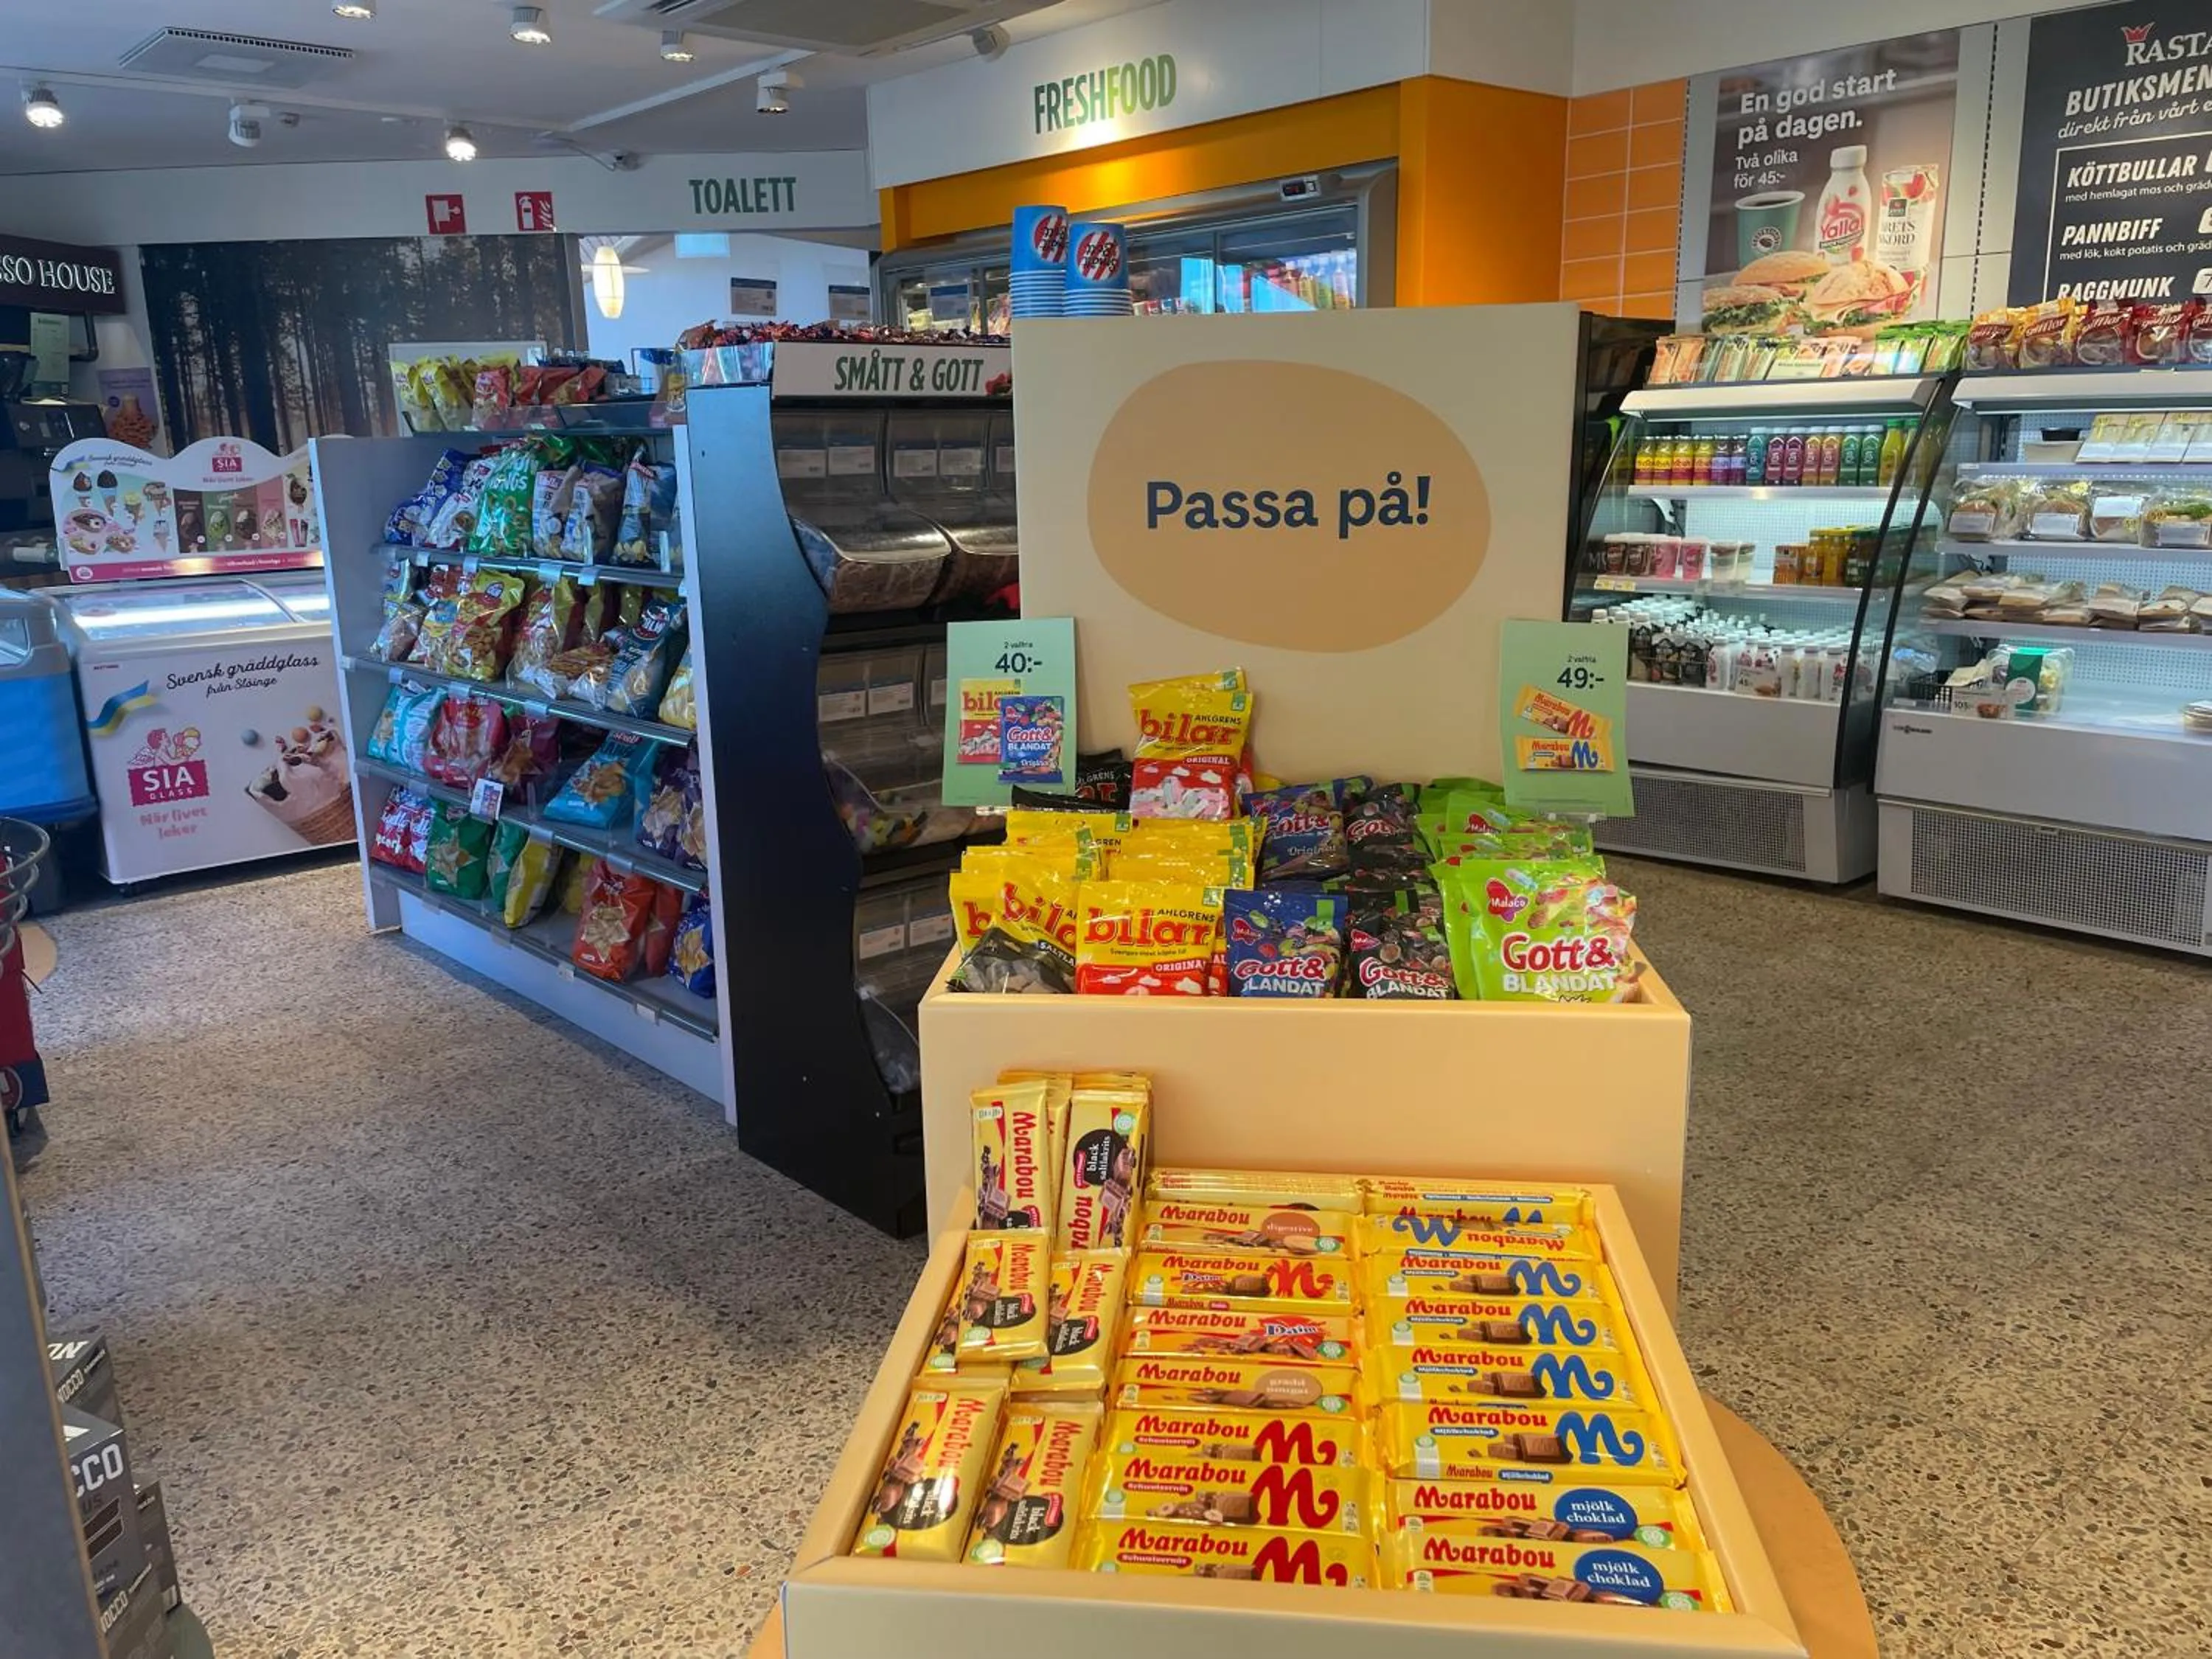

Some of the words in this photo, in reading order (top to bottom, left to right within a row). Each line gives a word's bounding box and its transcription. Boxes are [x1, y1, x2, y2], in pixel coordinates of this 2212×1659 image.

[1034, 53, 1177, 135] FRESHFOOD
[1741, 92, 1768, 114] En
[1776, 79, 1825, 114] god
[1832, 69, 1897, 100] start
[1738, 117, 1768, 149] på
[1775, 109, 1863, 140] dagen.
[2059, 116, 2110, 139] direkt
[2113, 109, 2154, 129] från
[2158, 100, 2199, 119] vårt
[1736, 152, 1760, 170] Två
[1764, 149, 1798, 166] olika
[1733, 173, 1754, 189] för
[1757, 171, 1786, 187] 45:-
[2067, 155, 2198, 188] KÖTTBULLAR
[689, 177, 797, 215] TOALETT
[2065, 192, 2087, 203] med
[2090, 188, 2137, 201] hemlagat
[2140, 186, 2162, 195] mos
[2164, 183, 2183, 193] och
[2062, 218, 2163, 246] PANNBIFF
[2059, 249, 2081, 260] med
[2104, 246, 2126, 257] kokt
[2127, 244, 2163, 257] potatis
[2166, 243, 2185, 252] och
[38, 259, 116, 294] HOUSE
[2057, 276, 2176, 303] RAGGMUNK
[834, 349, 905, 392] SMÅTT
[909, 359, 925, 392] &
[932, 358, 984, 392] GOTT
[1147, 481, 1319, 529] Passa
[1338, 471, 1431, 540] på!
[166, 667, 225, 690] Svensk
[227, 653, 320, 680] gräddglass
[995, 653, 1043, 673] 40:-
[206, 684, 233, 698] från
[235, 677, 278, 693] Slöinge
[1557, 667, 1604, 689] 49:-
[1140, 709, 1241, 745] bilar
[1194, 714, 1242, 725] AHLGRENS
[1007, 742, 1053, 751] BLANDAT
[1186, 756, 1231, 765] ORIGINAL
[142, 766, 195, 792] SIA
[149, 787, 193, 800] GLASS
[171, 807, 208, 824] livet
[159, 824, 198, 841] leker
[1491, 897, 1526, 908] Malaco
[1157, 908, 1216, 922] AHLGRENS
[1085, 907, 1211, 947] bilar
[1503, 973, 1615, 994] BLANDAT
[1012, 1111, 1038, 1199] Marabou
[1087, 1144, 1099, 1172] black
[1068, 1196, 1093, 1250] rabou
[1160, 1206, 1250, 1225] Marabou
[1267, 1223, 1313, 1234] digestive
[1467, 1232, 1565, 1251] Marabou
[1009, 1243, 1037, 1290] Marabou
[1162, 1255, 1260, 1272] Marabou
[1401, 1256, 1502, 1271] Marabou
[1405, 1299, 1512, 1317] Marabou
[1147, 1310, 1247, 1329] Marabou
[1411, 1347, 1525, 1367] Marabou
[1136, 1363, 1241, 1385] Marabou
[1135, 1414, 1251, 1439] Marabou
[1428, 1406, 1548, 1427] Marabou
[1039, 1420, 1084, 1488] Marabou
[1124, 1457, 1247, 1484] Marabou
[1446, 1465, 1493, 1478] Marabou
[1413, 1485, 1537, 1510] Marabou
[1571, 1500, 1615, 1512] mjölk
[1566, 1510, 1626, 1524] choklad
[1119, 1527, 1249, 1557] Marabou
[1424, 1537, 1556, 1568] Marabou
[1593, 1560, 1640, 1573] mjölk
[1587, 1571, 1652, 1589] choklad
